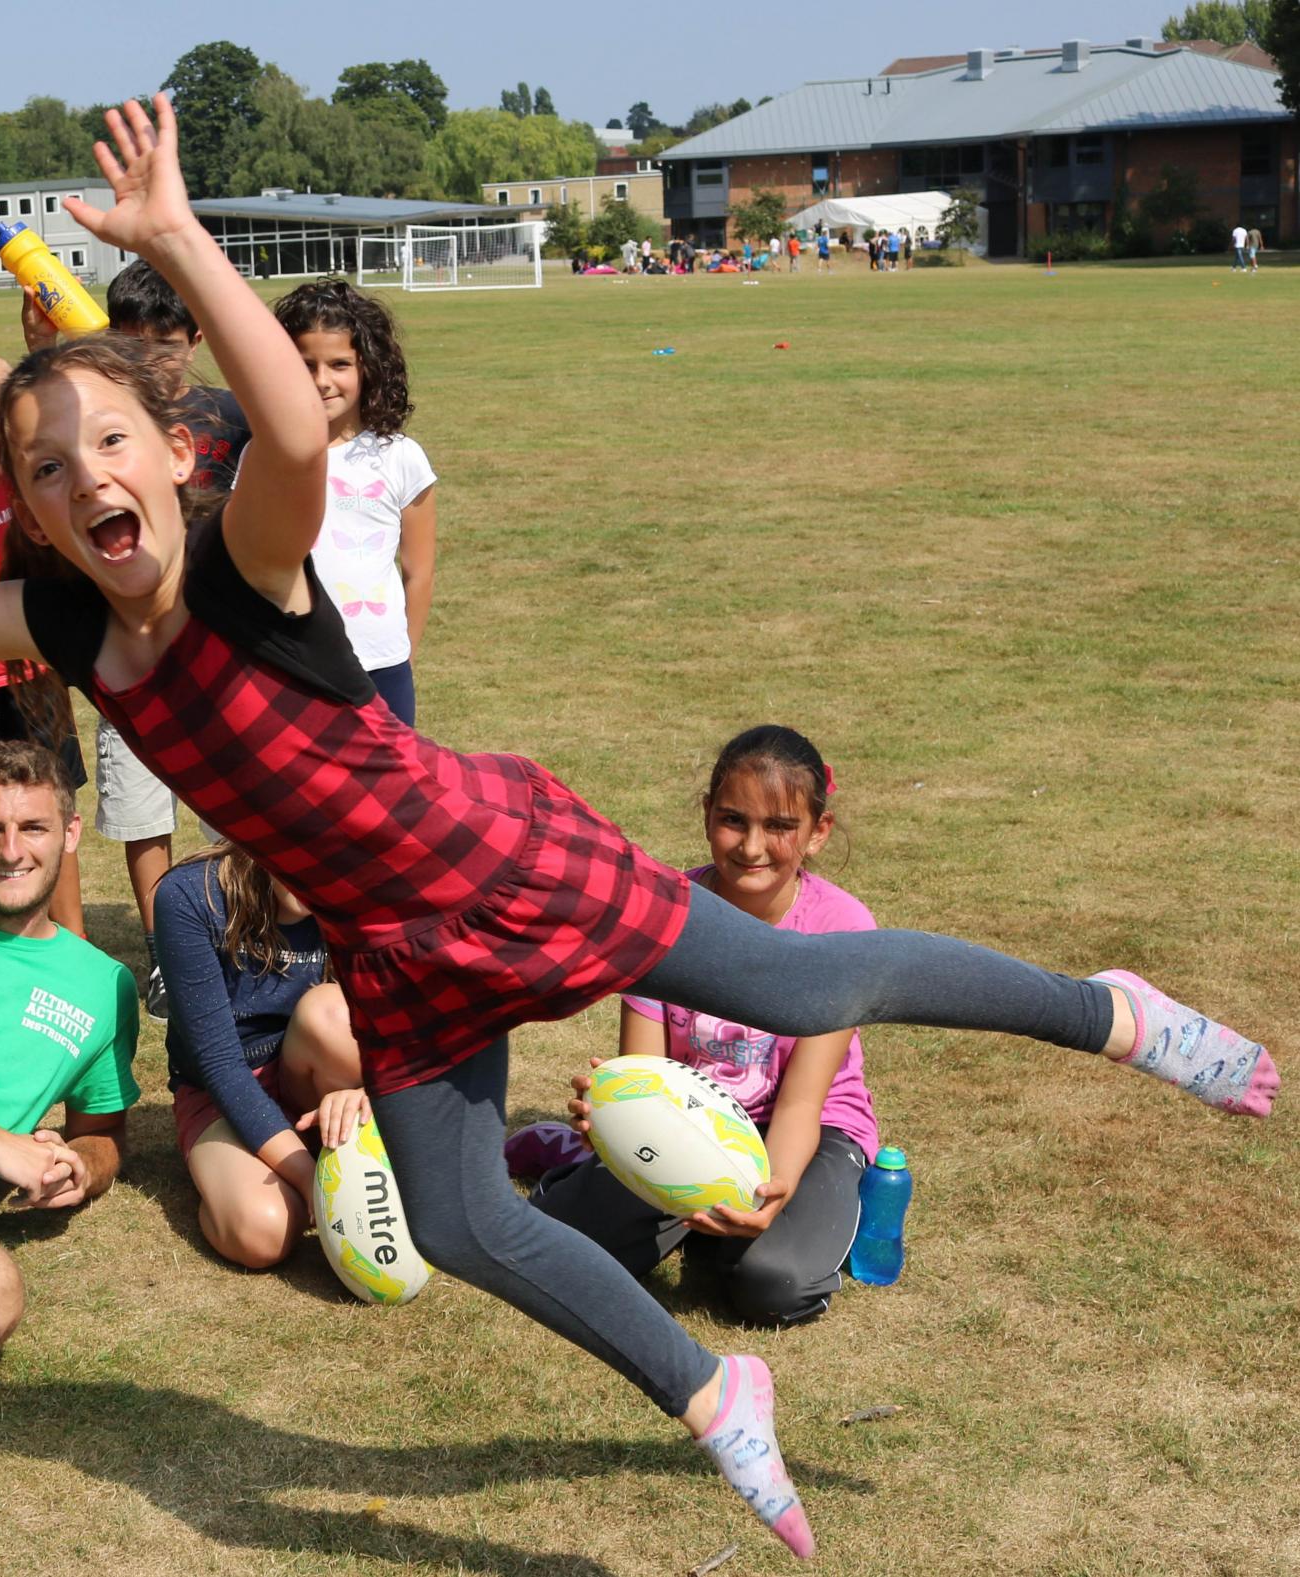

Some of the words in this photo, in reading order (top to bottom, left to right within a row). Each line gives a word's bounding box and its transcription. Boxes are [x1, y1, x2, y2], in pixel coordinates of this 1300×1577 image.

[24, 1001, 90, 1043] ACTIVITY
[30, 986, 96, 1032] ULTIMATE
[21, 1016, 80, 1059] INSTRUCTOR
[364, 1170, 398, 1265] mitre
